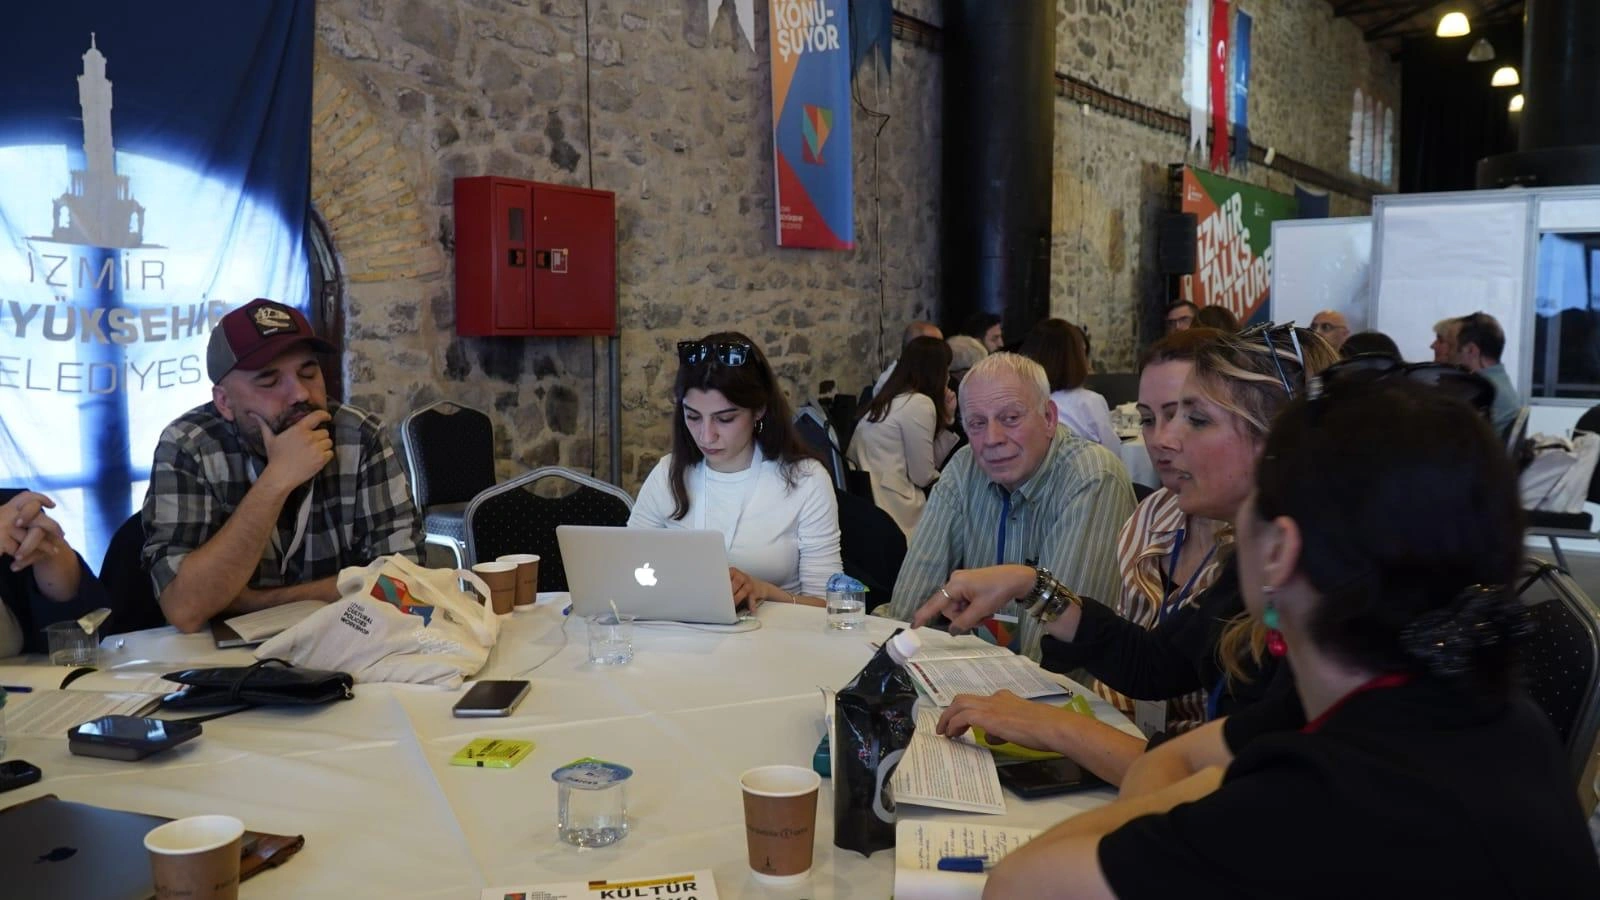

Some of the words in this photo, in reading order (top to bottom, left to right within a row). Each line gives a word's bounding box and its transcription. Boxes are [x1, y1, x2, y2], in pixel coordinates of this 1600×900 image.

[777, 24, 840, 63] ŞUYOR
[1200, 227, 1252, 306] TALKS
[0, 293, 226, 348] YÜKŞEHİR
[0, 353, 202, 394] ELEDİYES
[601, 881, 698, 899] KÜLTÜR
